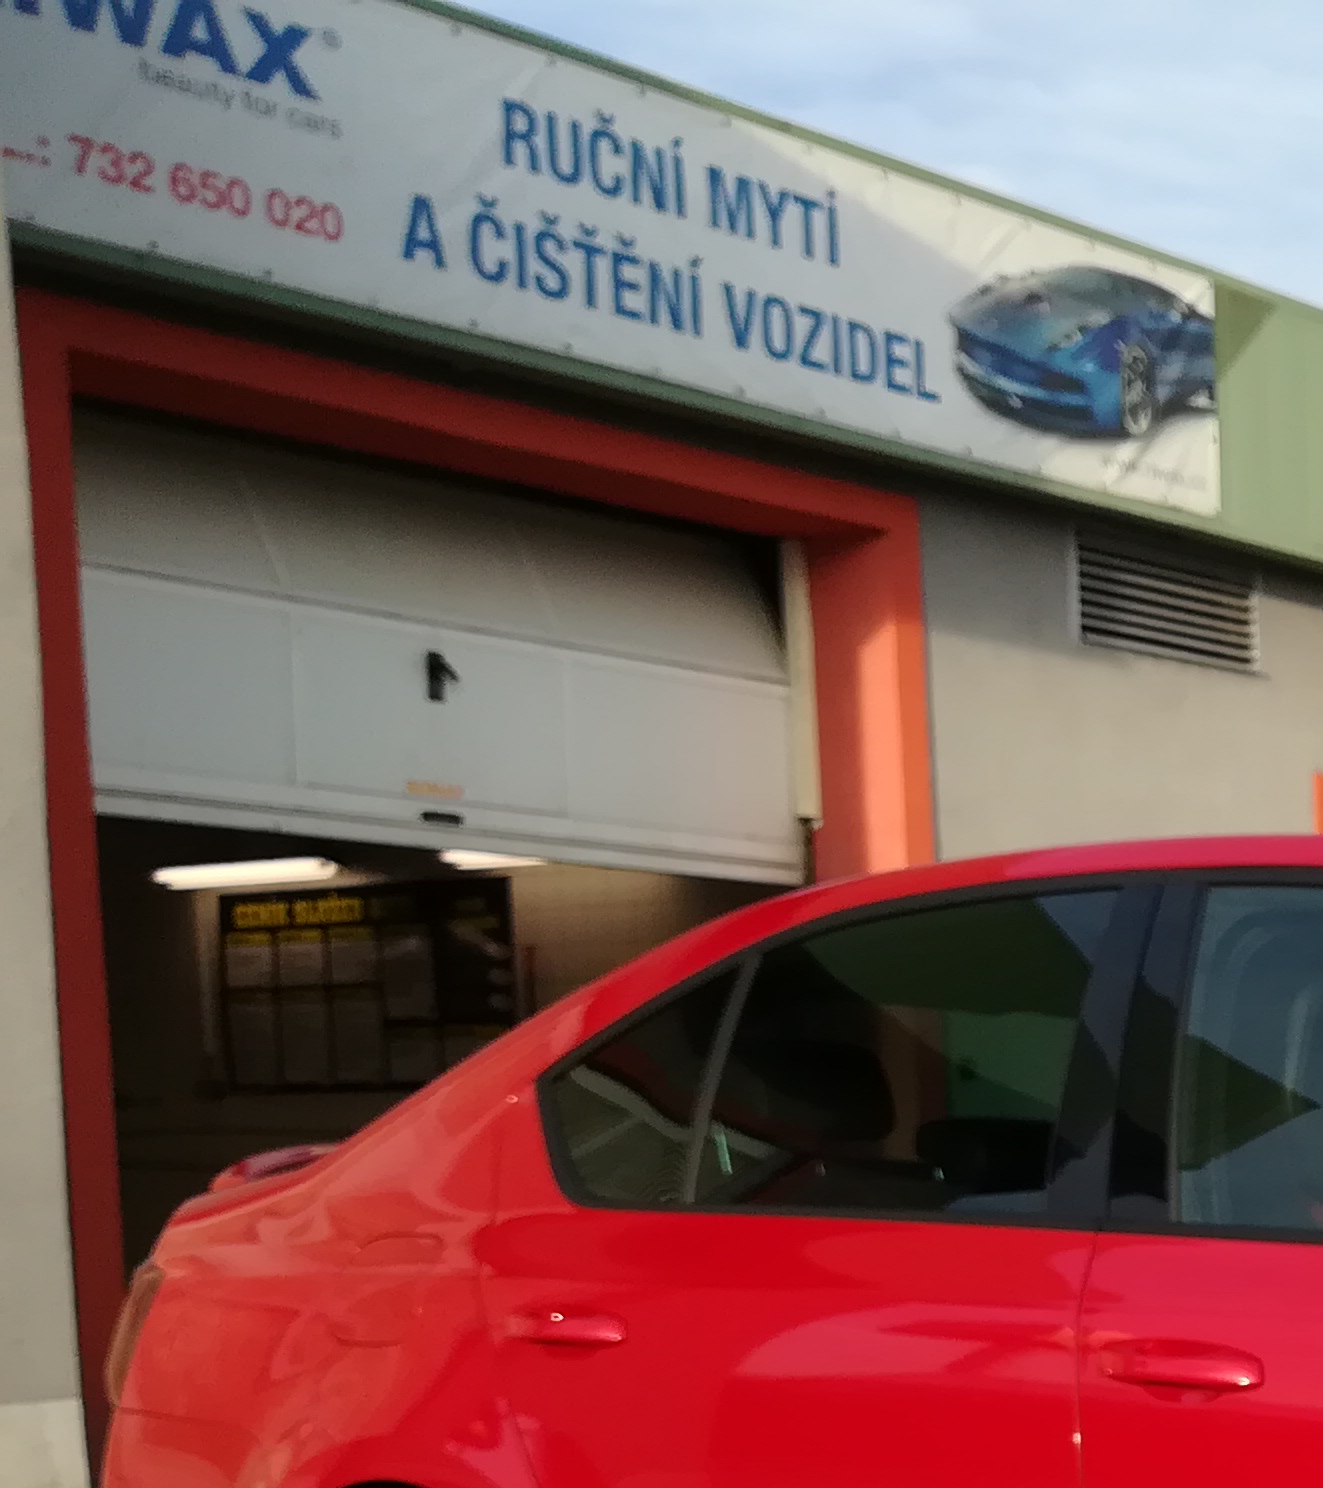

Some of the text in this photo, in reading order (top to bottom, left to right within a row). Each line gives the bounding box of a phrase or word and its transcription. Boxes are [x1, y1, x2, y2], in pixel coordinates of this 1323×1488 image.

[66, 132, 155, 193] 732
[167, 161, 251, 218] 650
[265, 188, 344, 241] 020
[501, 97, 840, 268] RUČNÍ MYTÍ
[403, 192, 447, 271] A
[720, 279, 943, 404] VOZIDEL
